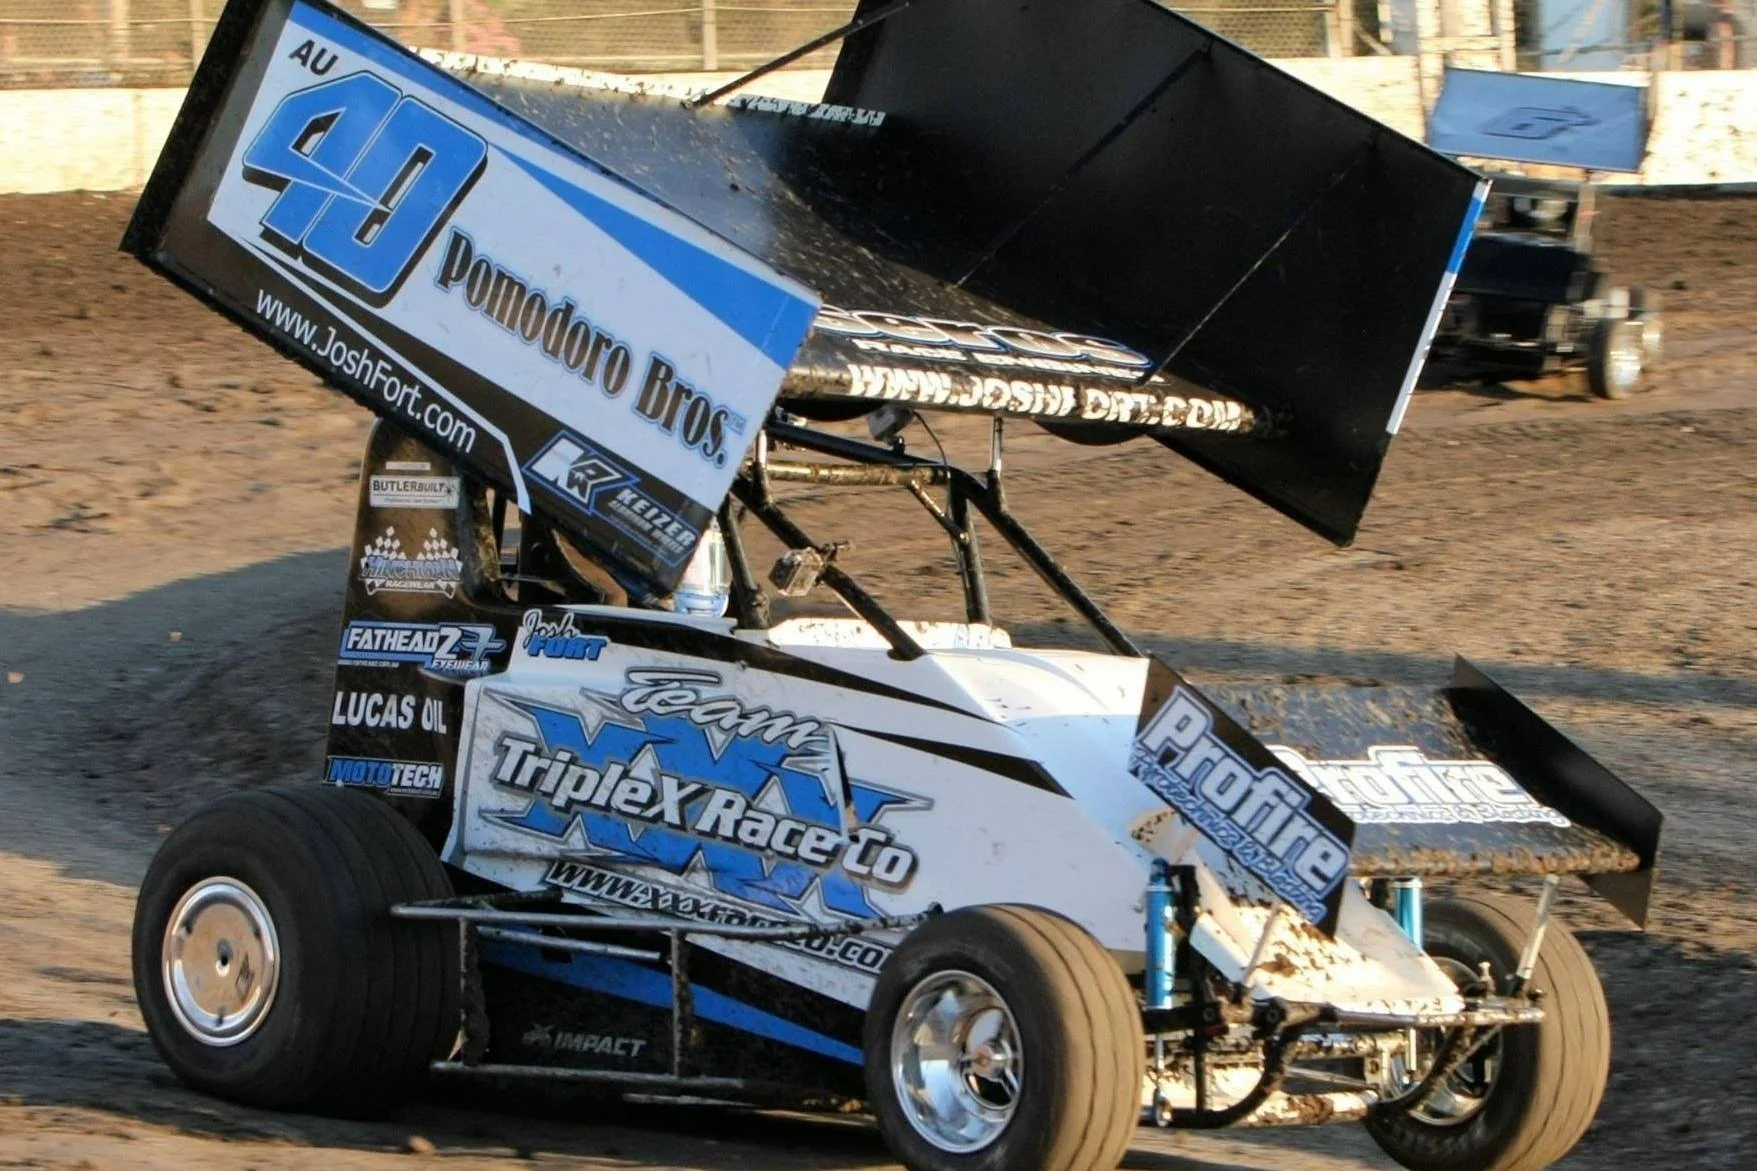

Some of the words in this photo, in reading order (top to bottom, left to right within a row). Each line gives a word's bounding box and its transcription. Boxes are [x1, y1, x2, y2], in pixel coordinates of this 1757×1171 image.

[288, 39, 339, 76] AU
[242, 69, 488, 309] 40
[256, 289, 477, 454] www.JoshFort.com
[435, 229, 632, 397] Pomodoro
[634, 353, 731, 468] Bros.
[615, 488, 697, 547] KEIZER
[332, 691, 416, 729] LUCAS
[421, 697, 447, 735] OIL
[620, 666, 829, 749] Team
[330, 759, 444, 789] MOTOTECH
[1138, 685, 1352, 899] Profire
[692, 788, 845, 866] Race
[555, 1031, 648, 1057] IMPACT
